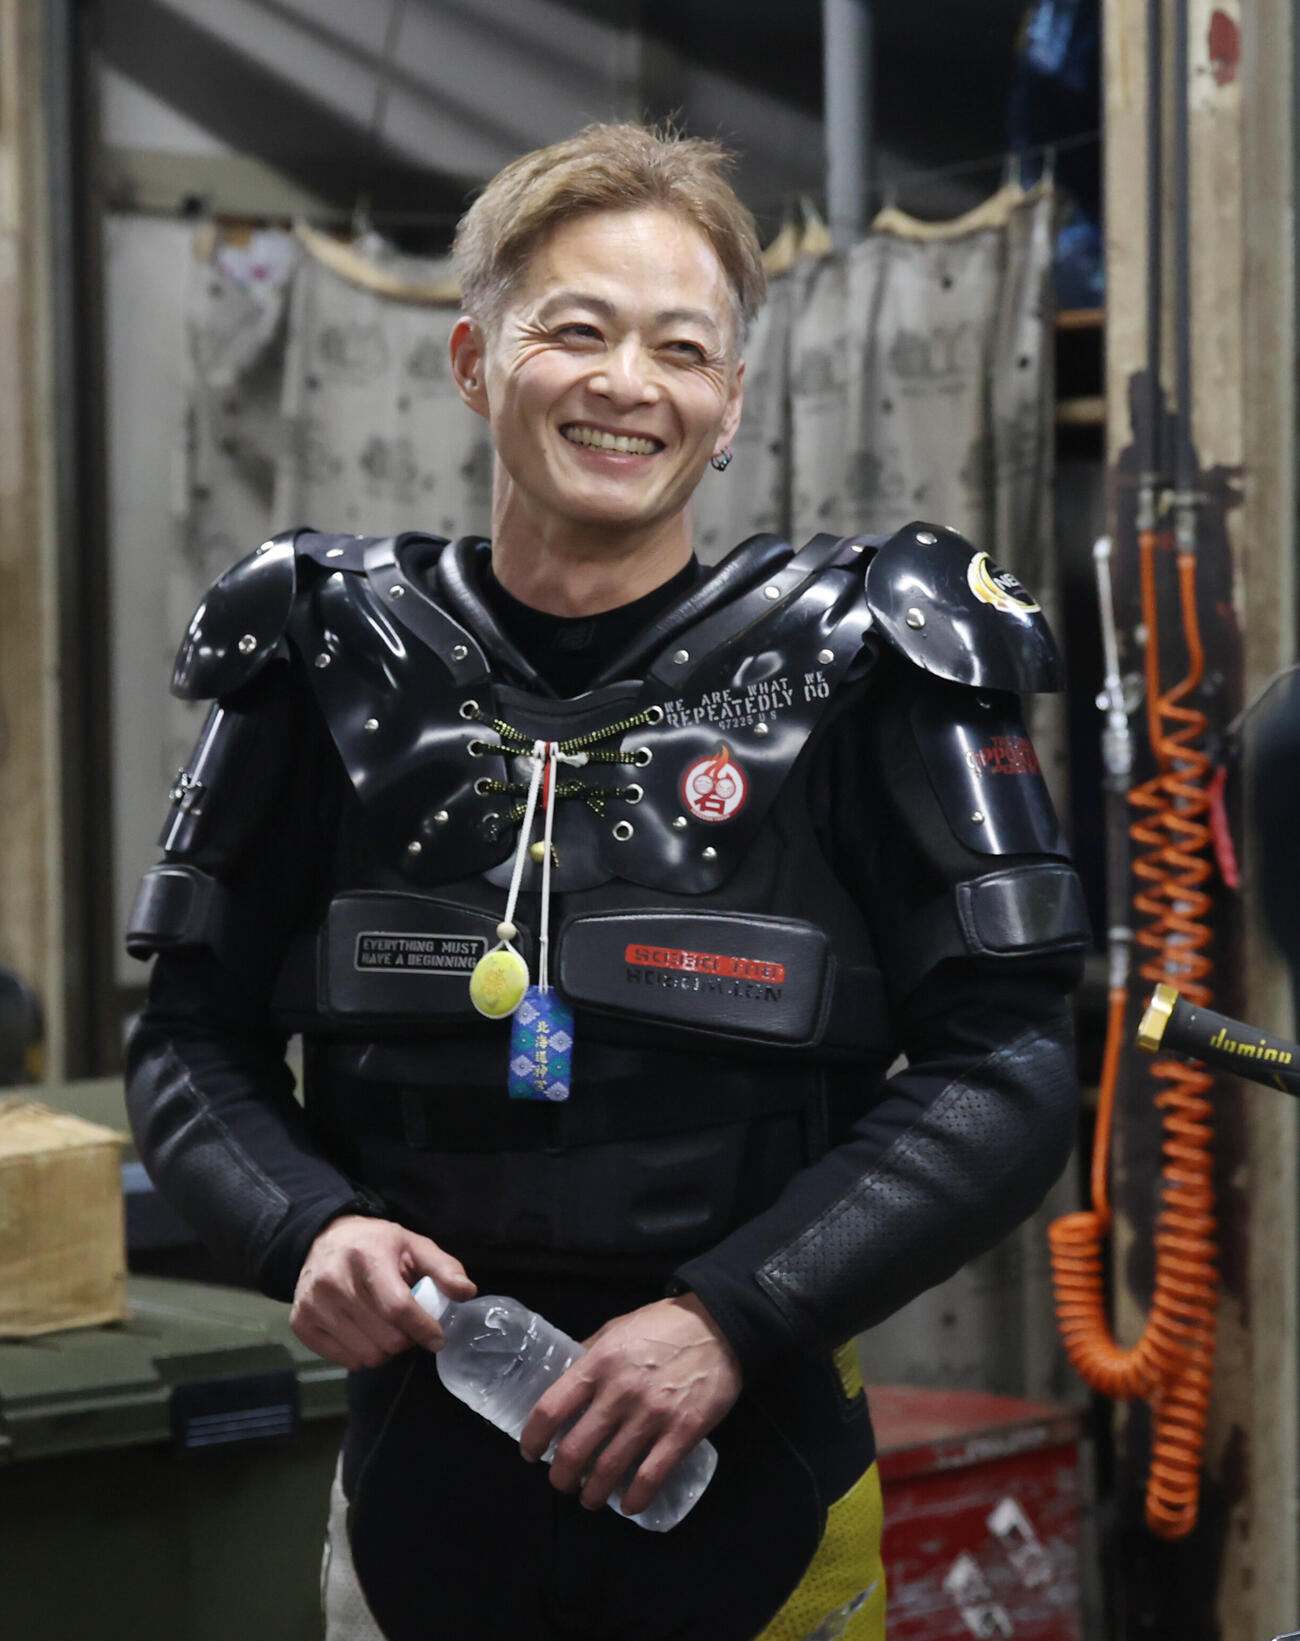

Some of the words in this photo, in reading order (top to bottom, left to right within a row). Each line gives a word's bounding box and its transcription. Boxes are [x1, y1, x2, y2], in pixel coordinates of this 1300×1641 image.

[664, 698, 685, 713] WE
[702, 689, 732, 706] ARE
[747, 677, 788, 696] WHAT
[804, 671, 826, 685] WE
[666, 689, 793, 729] REPEATEDLY
[804, 683, 829, 702] DO
[361, 953, 391, 965] HAVE
[395, 954, 404, 965] A
[407, 955, 477, 968] BEGINNING
[363, 938, 434, 953] EVERYTHING
[441, 941, 478, 955] MUST
